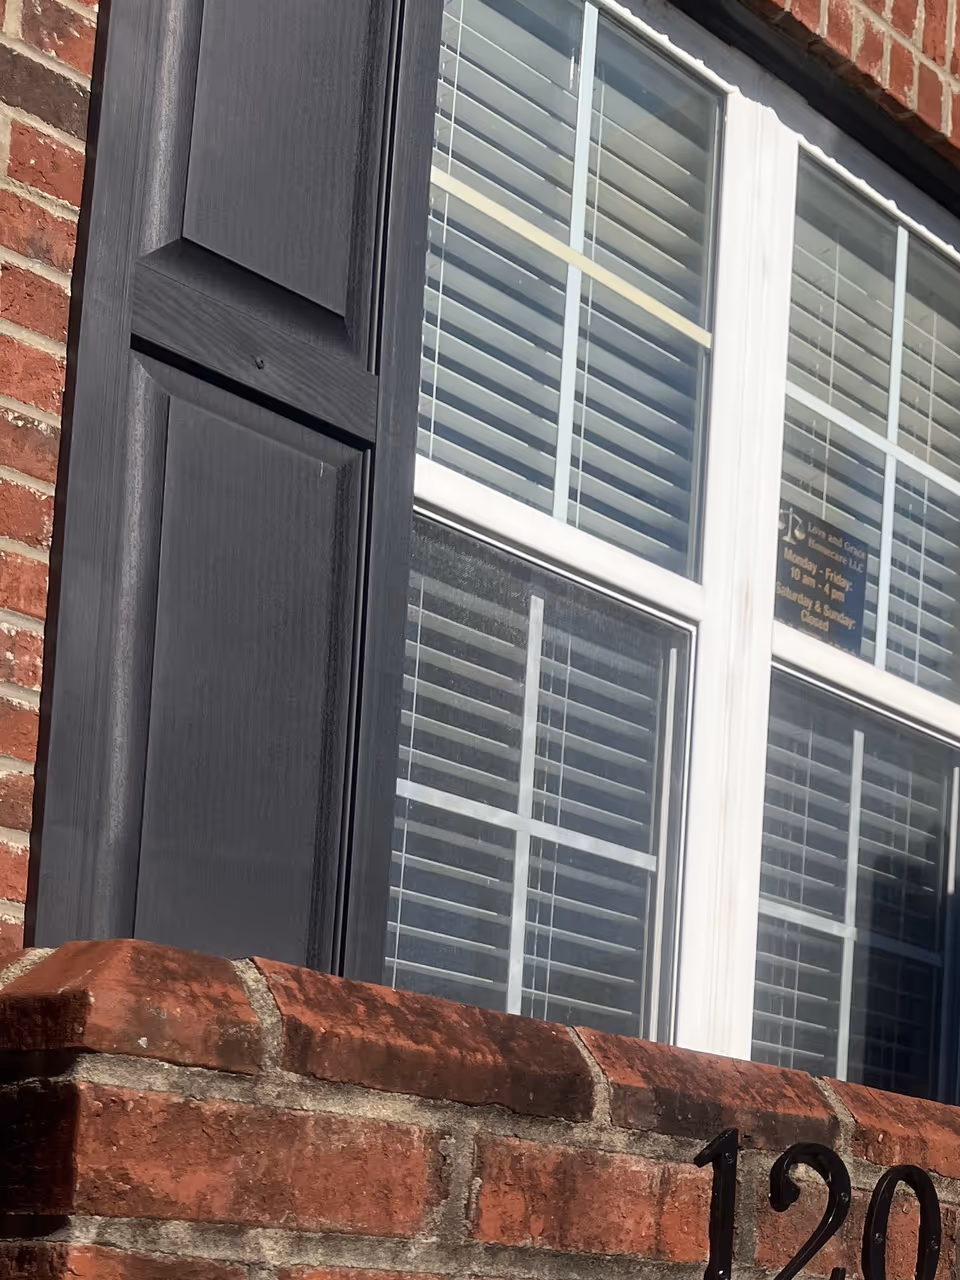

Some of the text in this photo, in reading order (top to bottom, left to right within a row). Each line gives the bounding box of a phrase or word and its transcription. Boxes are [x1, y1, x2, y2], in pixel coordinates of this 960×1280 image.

[827, 532, 843, 548] and
[783, 547, 817, 575] Monday
[825, 568, 853, 592] Friday:
[790, 567, 801, 581] 10
[801, 574, 816, 590] am
[824, 583, 830, 596] 4
[830, 588, 845, 603] pm
[801, 610, 830, 633] Closed
[815, 600, 822, 613] &
[823, 604, 856, 630] Sunday:
